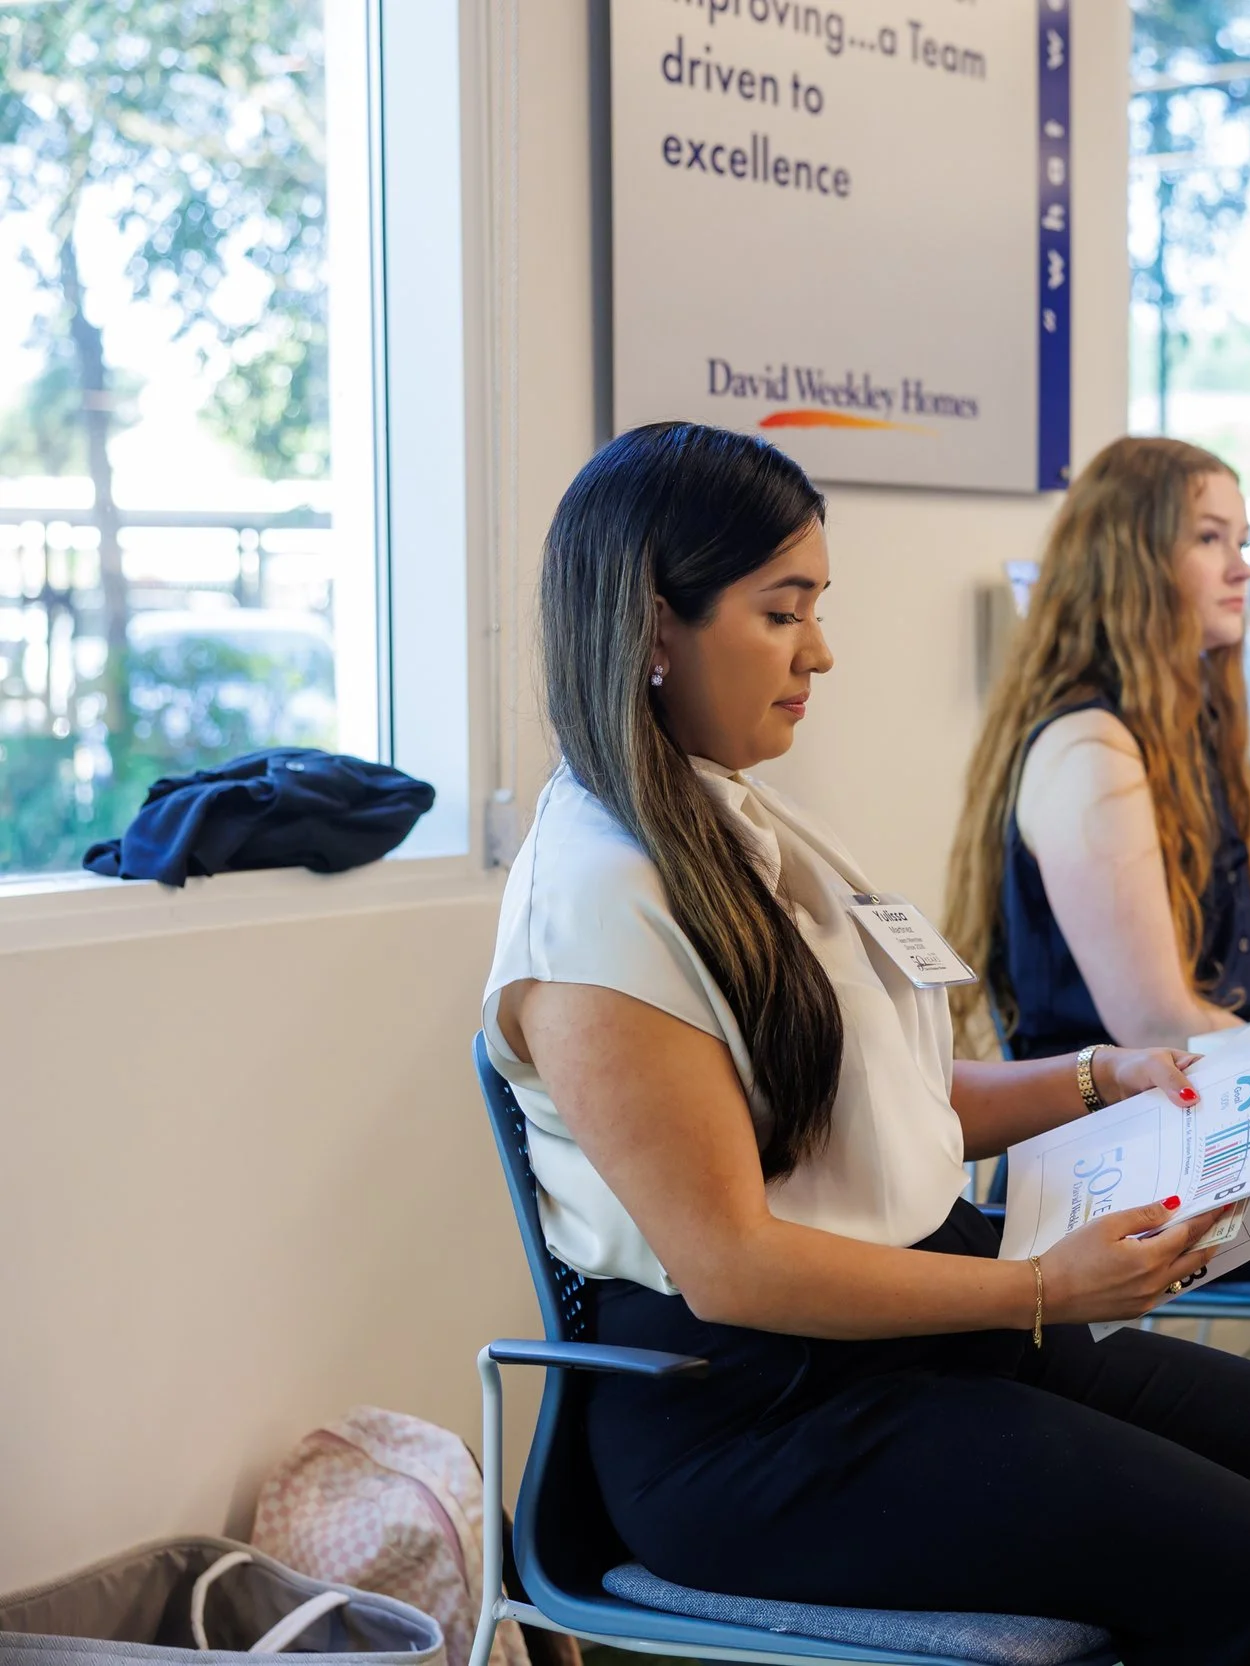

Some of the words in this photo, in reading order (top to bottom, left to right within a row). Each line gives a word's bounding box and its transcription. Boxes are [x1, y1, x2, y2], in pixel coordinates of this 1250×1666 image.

[661, 34, 780, 107] driven
[791, 71, 825, 115] to
[907, 19, 987, 81] Team
[661, 131, 851, 199] excellence
[707, 357, 790, 402] David
[794, 364, 896, 419] Weekley
[901, 376, 981, 419] Homes
[872, 910, 909, 922] Yulissa
[1071, 1181, 1083, 1205] David
[1073, 1146, 1123, 1196] 50
[1213, 1182, 1247, 1200] B
